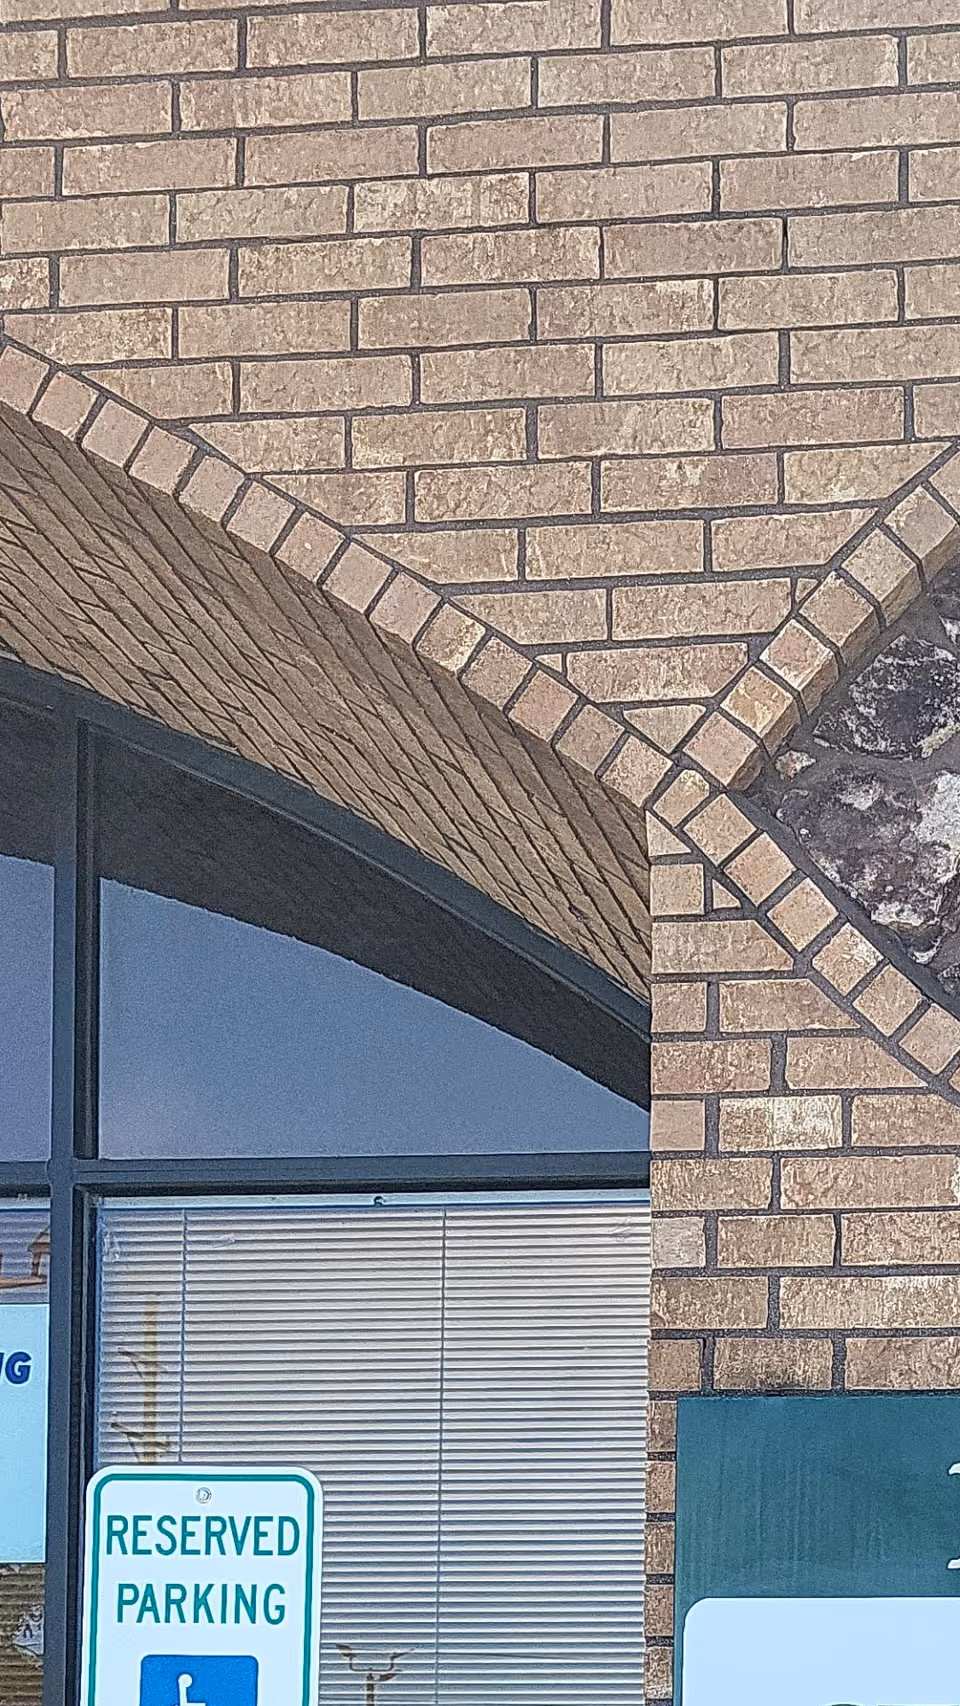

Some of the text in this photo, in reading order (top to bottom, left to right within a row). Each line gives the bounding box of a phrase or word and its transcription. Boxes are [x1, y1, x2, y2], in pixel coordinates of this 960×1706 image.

[0, 1352, 32, 1384] G
[106, 1514, 301, 1557] RESERVED
[116, 1583, 286, 1626] PARKING
